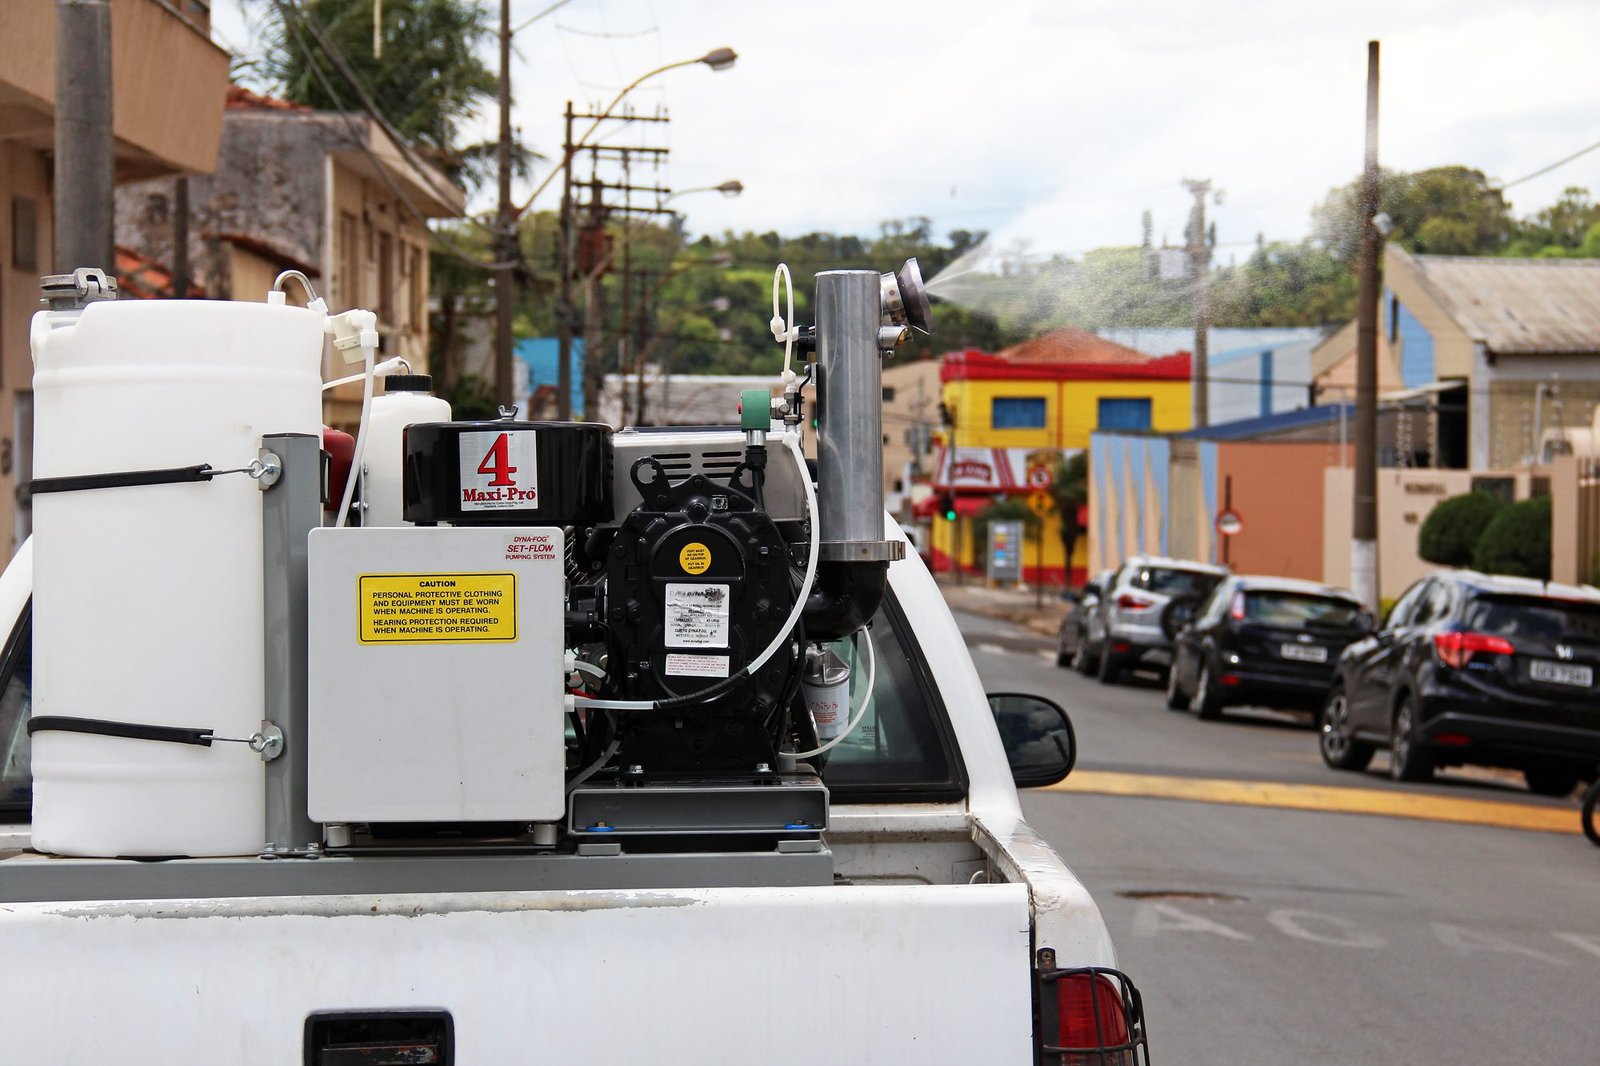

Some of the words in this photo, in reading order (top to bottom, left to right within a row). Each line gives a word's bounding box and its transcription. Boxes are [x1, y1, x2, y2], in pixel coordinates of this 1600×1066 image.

[477, 433, 517, 486] 4
[462, 488, 536, 501] Maxi-Pro
[507, 544, 553, 552] SET-FLOW
[419, 580, 456, 588] CAUTION
[464, 590, 503, 598] CLOTHING
[435, 607, 443, 615] IS
[445, 606, 491, 614] OPERATING.
[409, 618, 458, 626] PROTECTION
[399, 626, 434, 634] MACHINE
[445, 625, 491, 633] OPERATING.
